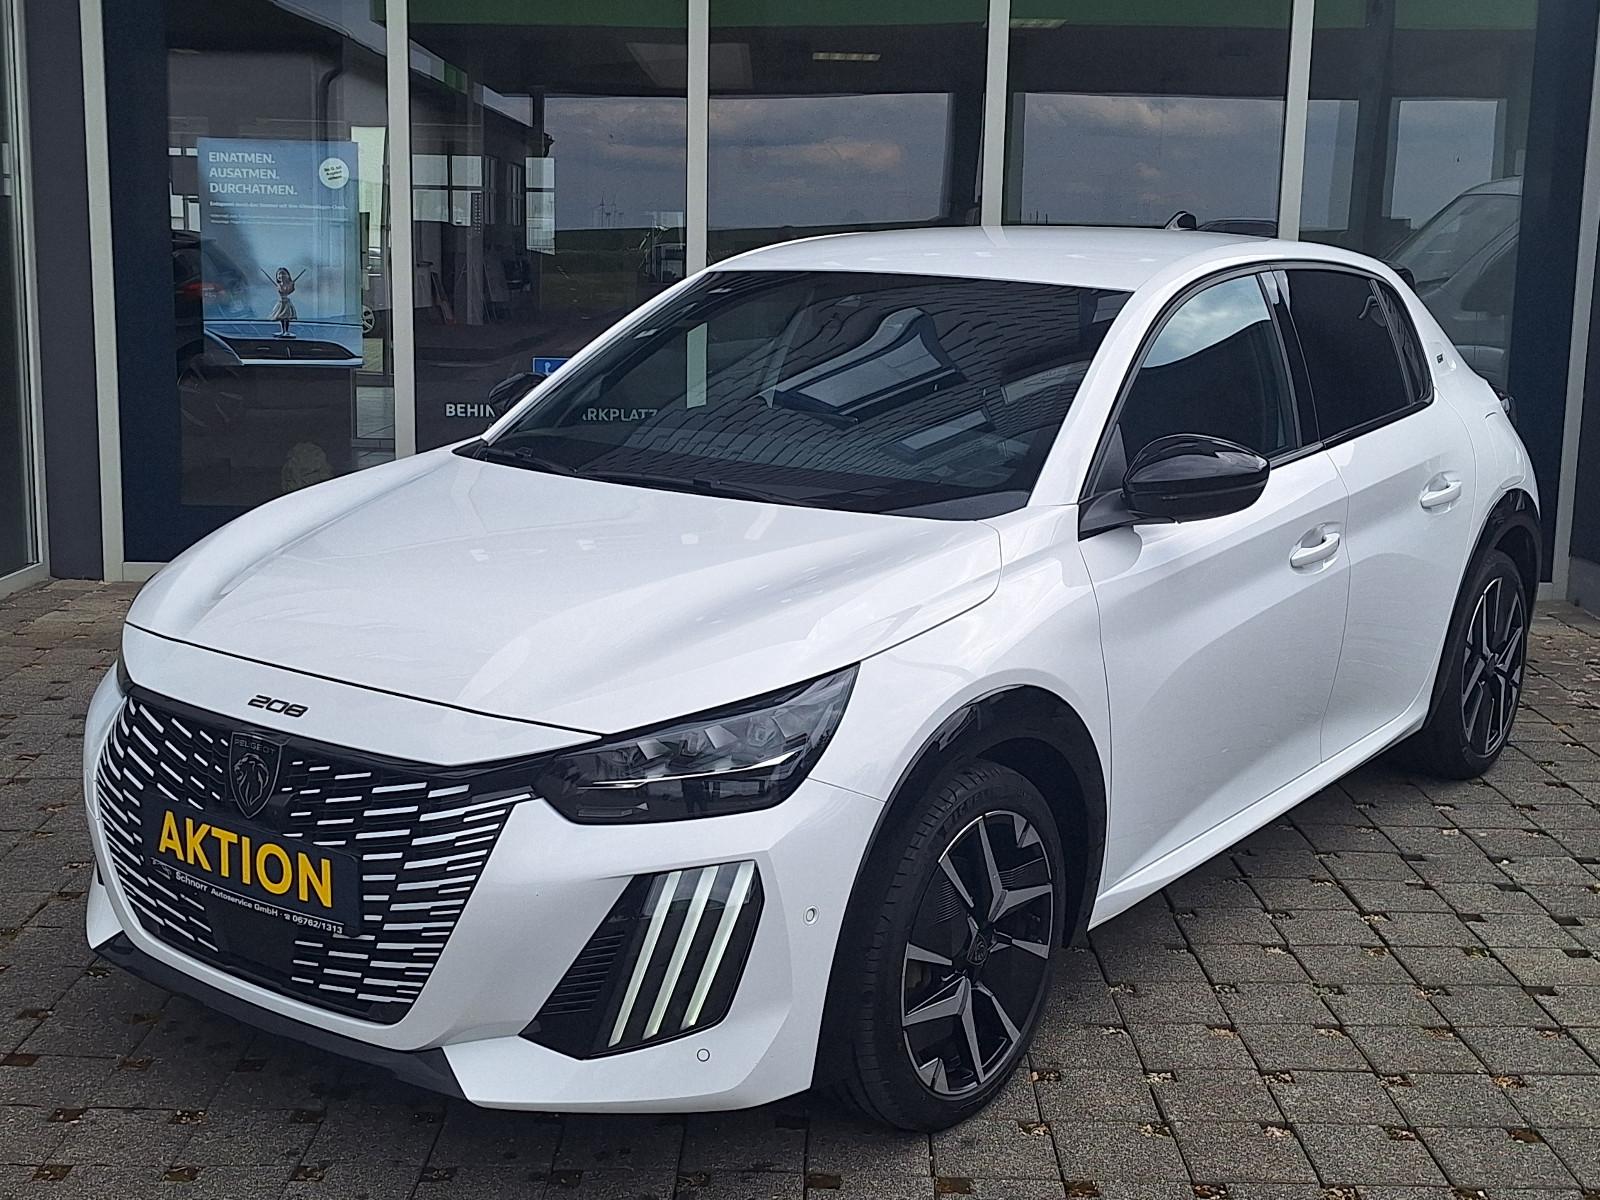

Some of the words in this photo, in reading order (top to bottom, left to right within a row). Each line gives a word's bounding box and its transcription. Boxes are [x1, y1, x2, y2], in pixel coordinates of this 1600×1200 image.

[208, 151, 276, 164] EINATMEN.
[209, 167, 280, 179] AUSATMEN.
[209, 182, 298, 195] DURCHATMEN.
[247, 694, 309, 718] 208
[158, 810, 332, 908] AKTION
[175, 870, 208, 893] Schnorr
[211, 887, 253, 909] Autoservice
[254, 903, 278, 917] GmbH
[292, 914, 343, 935] 06762/1313
